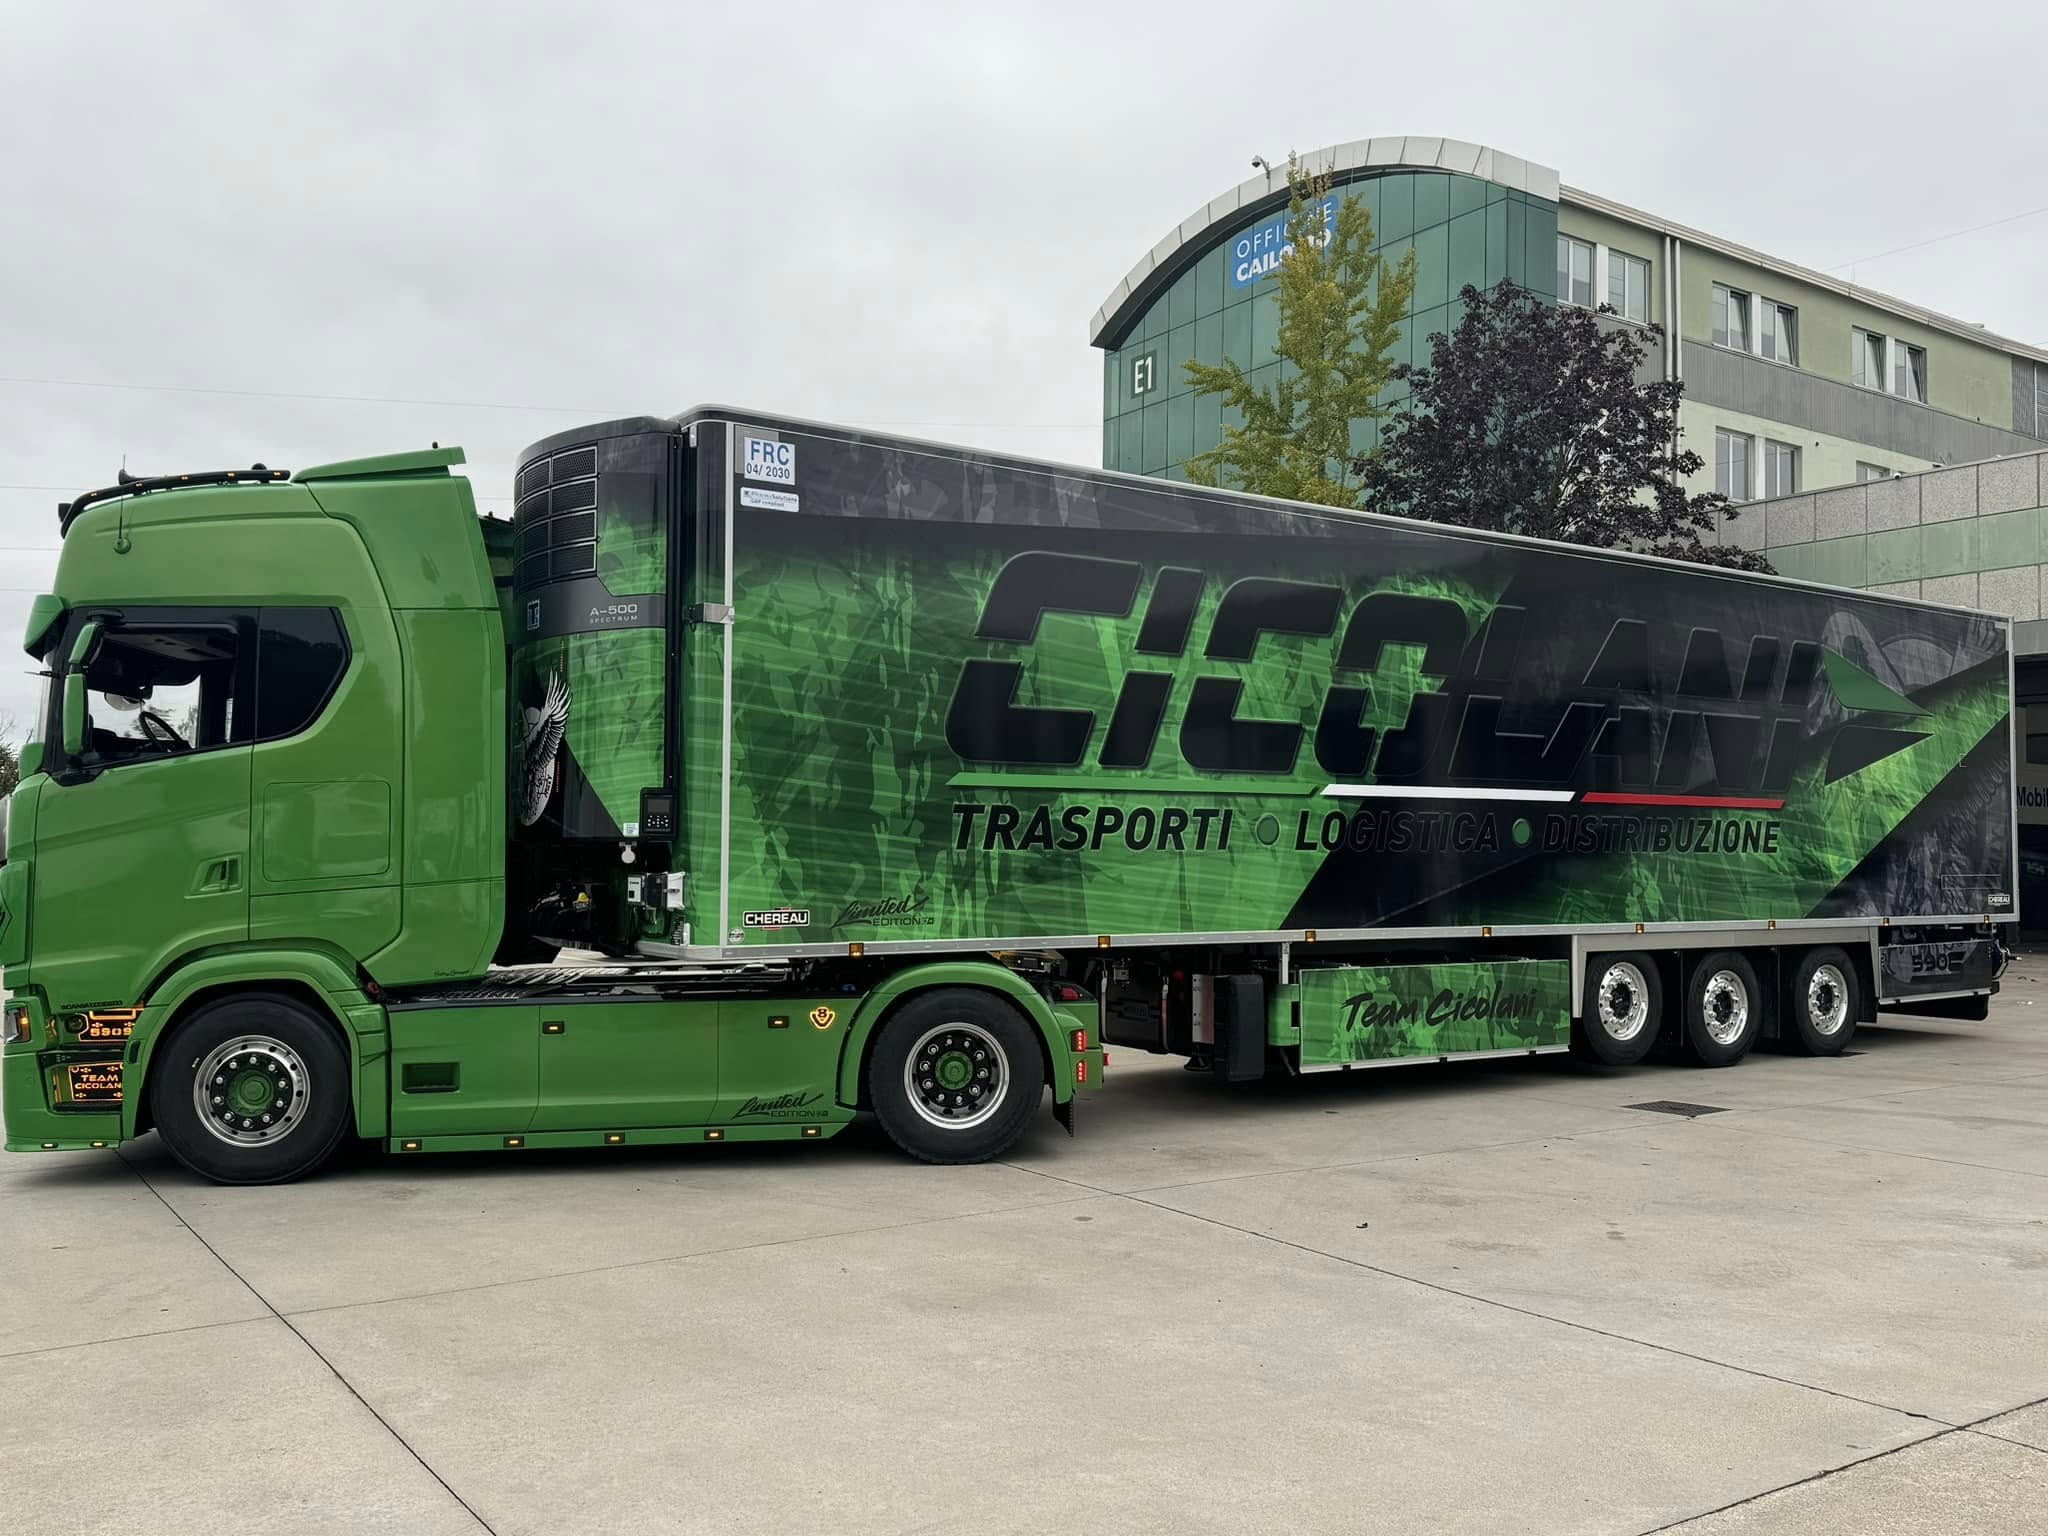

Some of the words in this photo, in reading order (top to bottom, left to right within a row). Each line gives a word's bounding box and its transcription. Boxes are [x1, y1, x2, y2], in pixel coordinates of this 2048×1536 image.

[1236, 202, 1332, 258] OFFIE
[1236, 228, 1332, 281] CAILOO
[1134, 356, 1153, 394] E1
[751, 440, 789, 466] FRC
[766, 466, 790, 479] 2030
[590, 604, 638, 616] A-500
[590, 615, 638, 624] SPECTRUM
[944, 550, 1822, 792] CICOLANI
[952, 804, 1234, 853] TRASPORTI
[1295, 809, 1499, 853] LOGISTICA
[1543, 815, 1784, 855] DISTRIBUZIONE
[745, 912, 808, 925] CHEREAU
[829, 895, 930, 930] Limited
[872, 917, 921, 927] EDITION
[1340, 992, 1418, 1032] Team
[1425, 980, 1538, 1026] Cicolani
[81, 1074, 119, 1082] TEAM
[731, 1092, 825, 1120] Limited
[771, 1109, 815, 1118] EDITION
